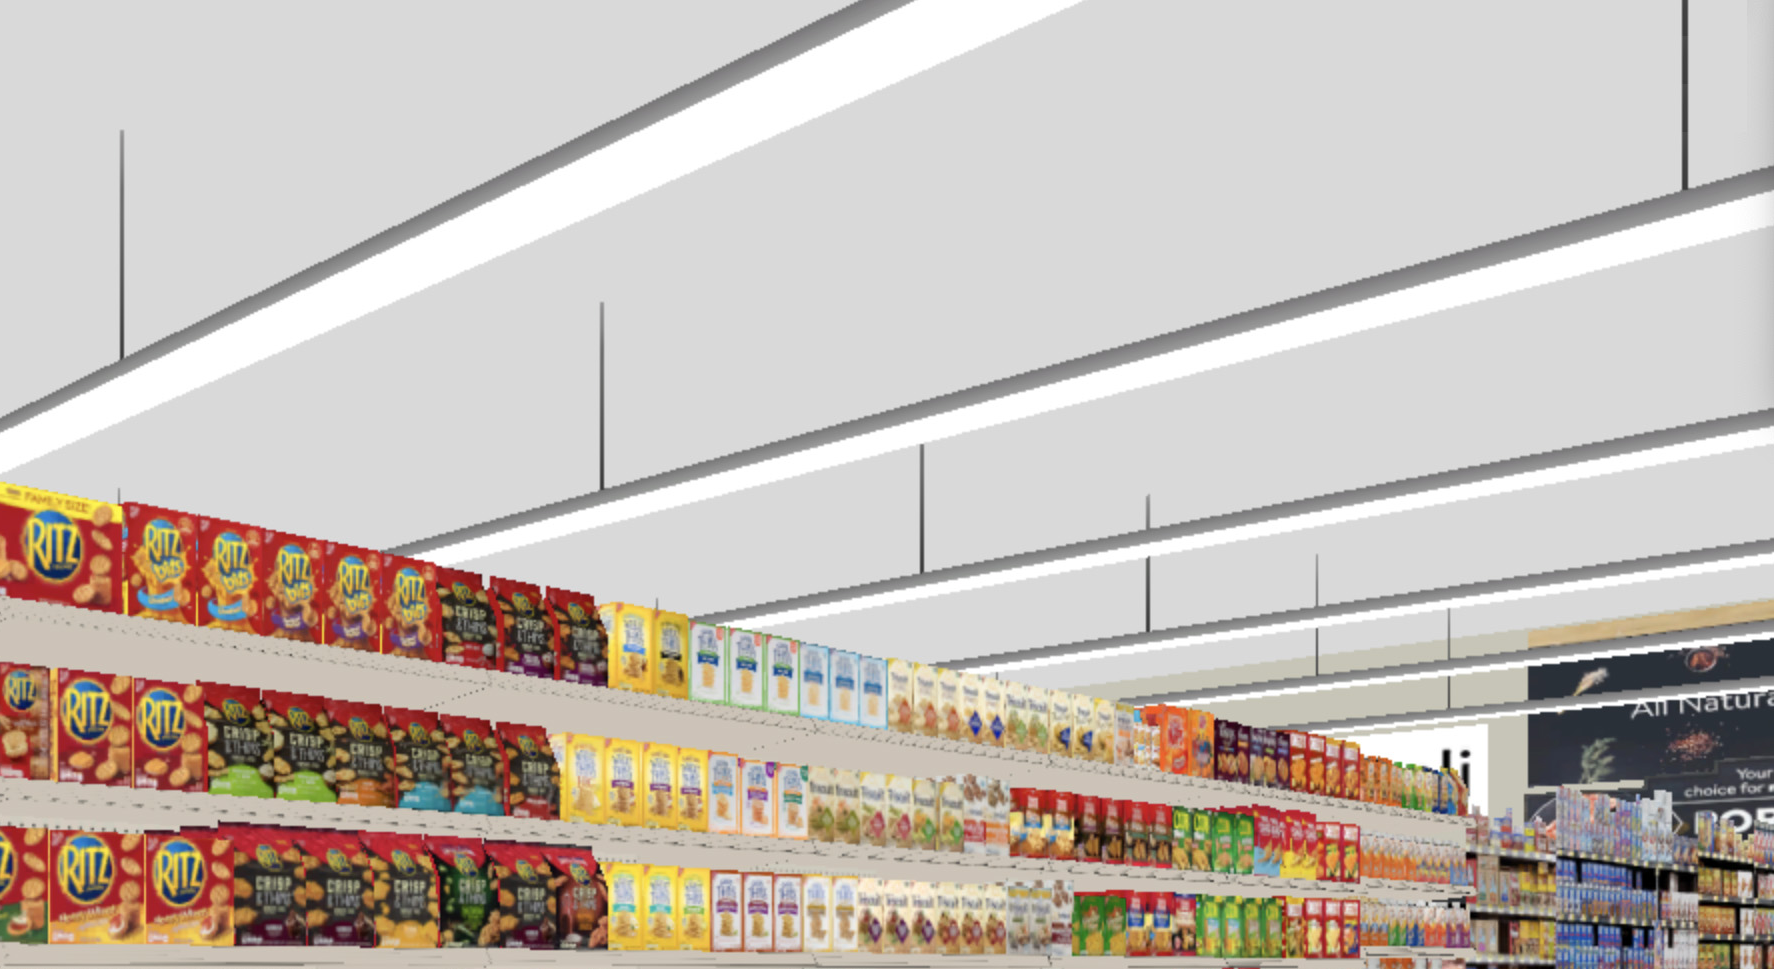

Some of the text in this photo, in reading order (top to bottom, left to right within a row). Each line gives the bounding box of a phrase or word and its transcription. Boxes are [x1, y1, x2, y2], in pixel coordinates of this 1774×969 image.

[26, 520, 83, 570] RITZ
[145, 525, 182, 560] RITZ
[214, 540, 250, 573] RITZ
[62, 686, 112, 734] RITZ
[140, 697, 186, 742] RITZ
[1631, 701, 1668, 719] All
[1684, 784, 1737, 798] choice
[1740, 782, 1765, 793] for
[1736, 768, 1773, 780] Your
[59, 846, 111, 894] RITZ
[154, 852, 202, 895] RITZ
